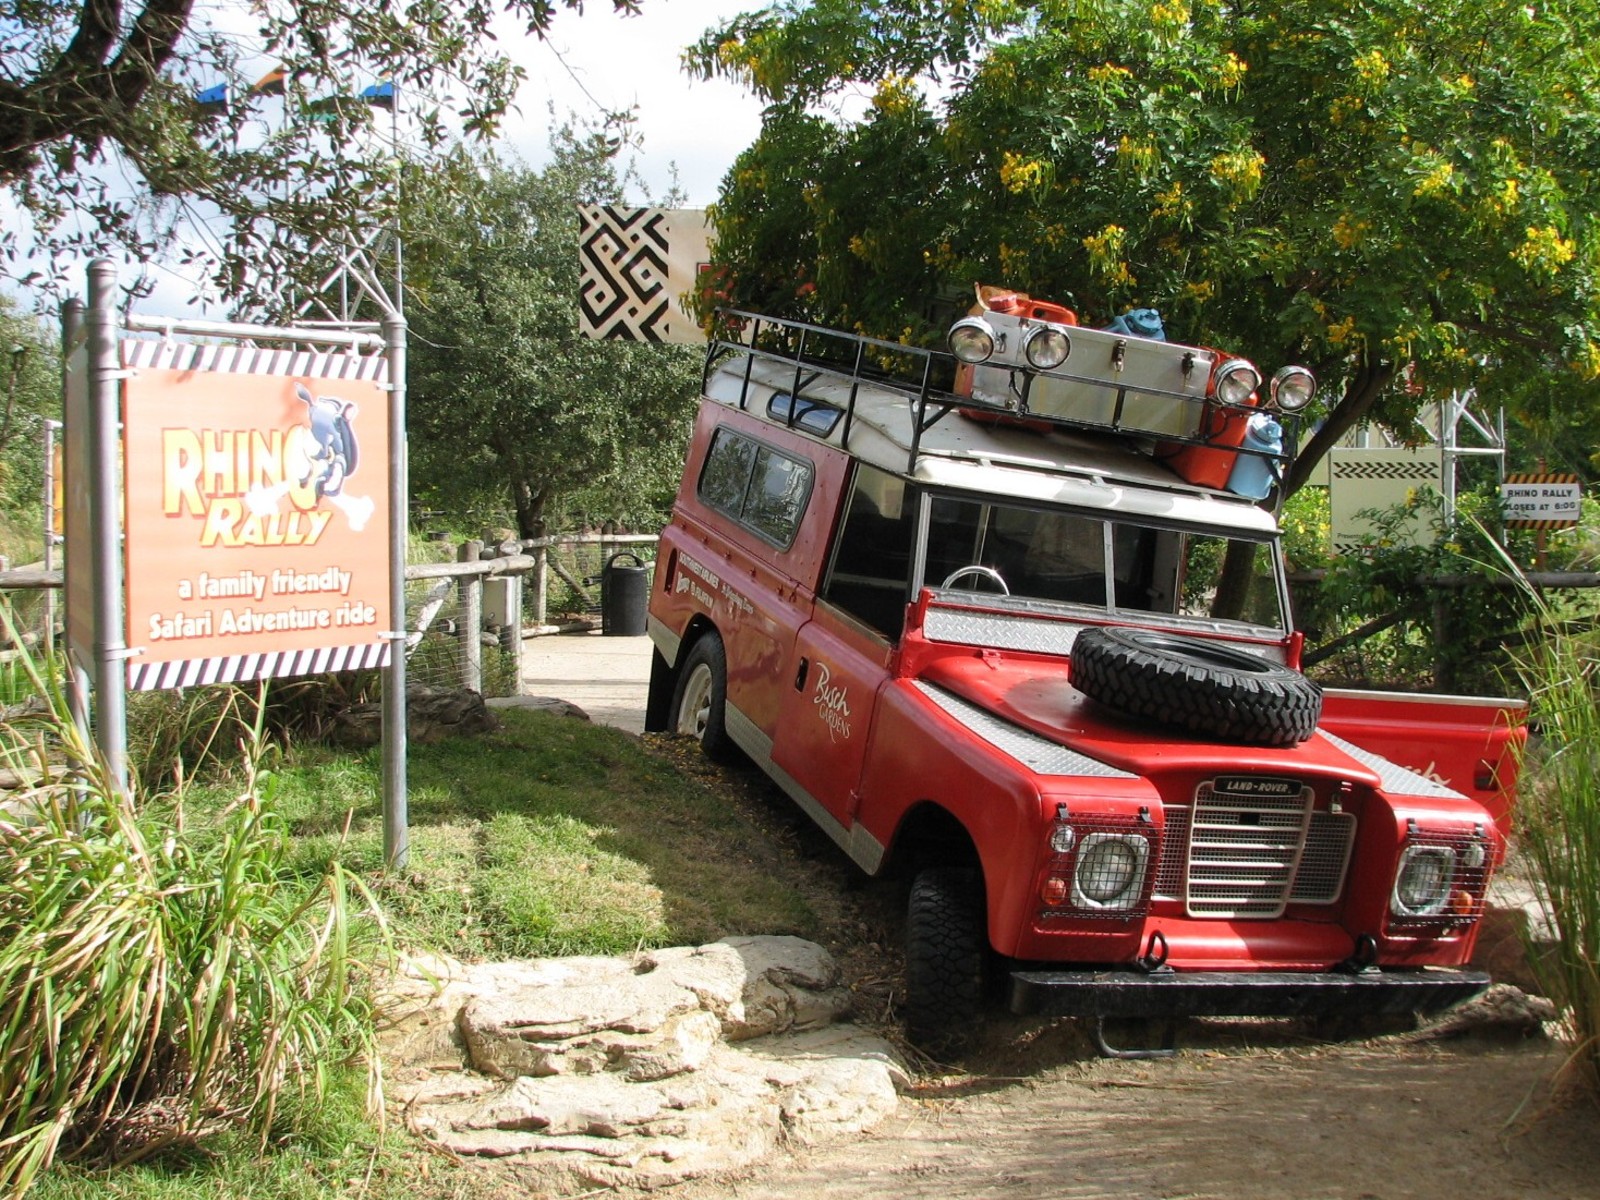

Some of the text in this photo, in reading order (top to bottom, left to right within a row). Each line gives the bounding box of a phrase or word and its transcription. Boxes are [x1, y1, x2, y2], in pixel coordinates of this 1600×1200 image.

[162, 424, 324, 518] RHINO
[1507, 489, 1573, 497] RHINO RALLY
[200, 496, 333, 548] RALLY
[178, 566, 351, 601] a family friendly
[149, 600, 376, 641] Safari Adventure ride
[814, 662, 850, 716] Busch
[819, 703, 851, 744] GARDENS
[1227, 781, 1288, 792] LAND-ROVER
